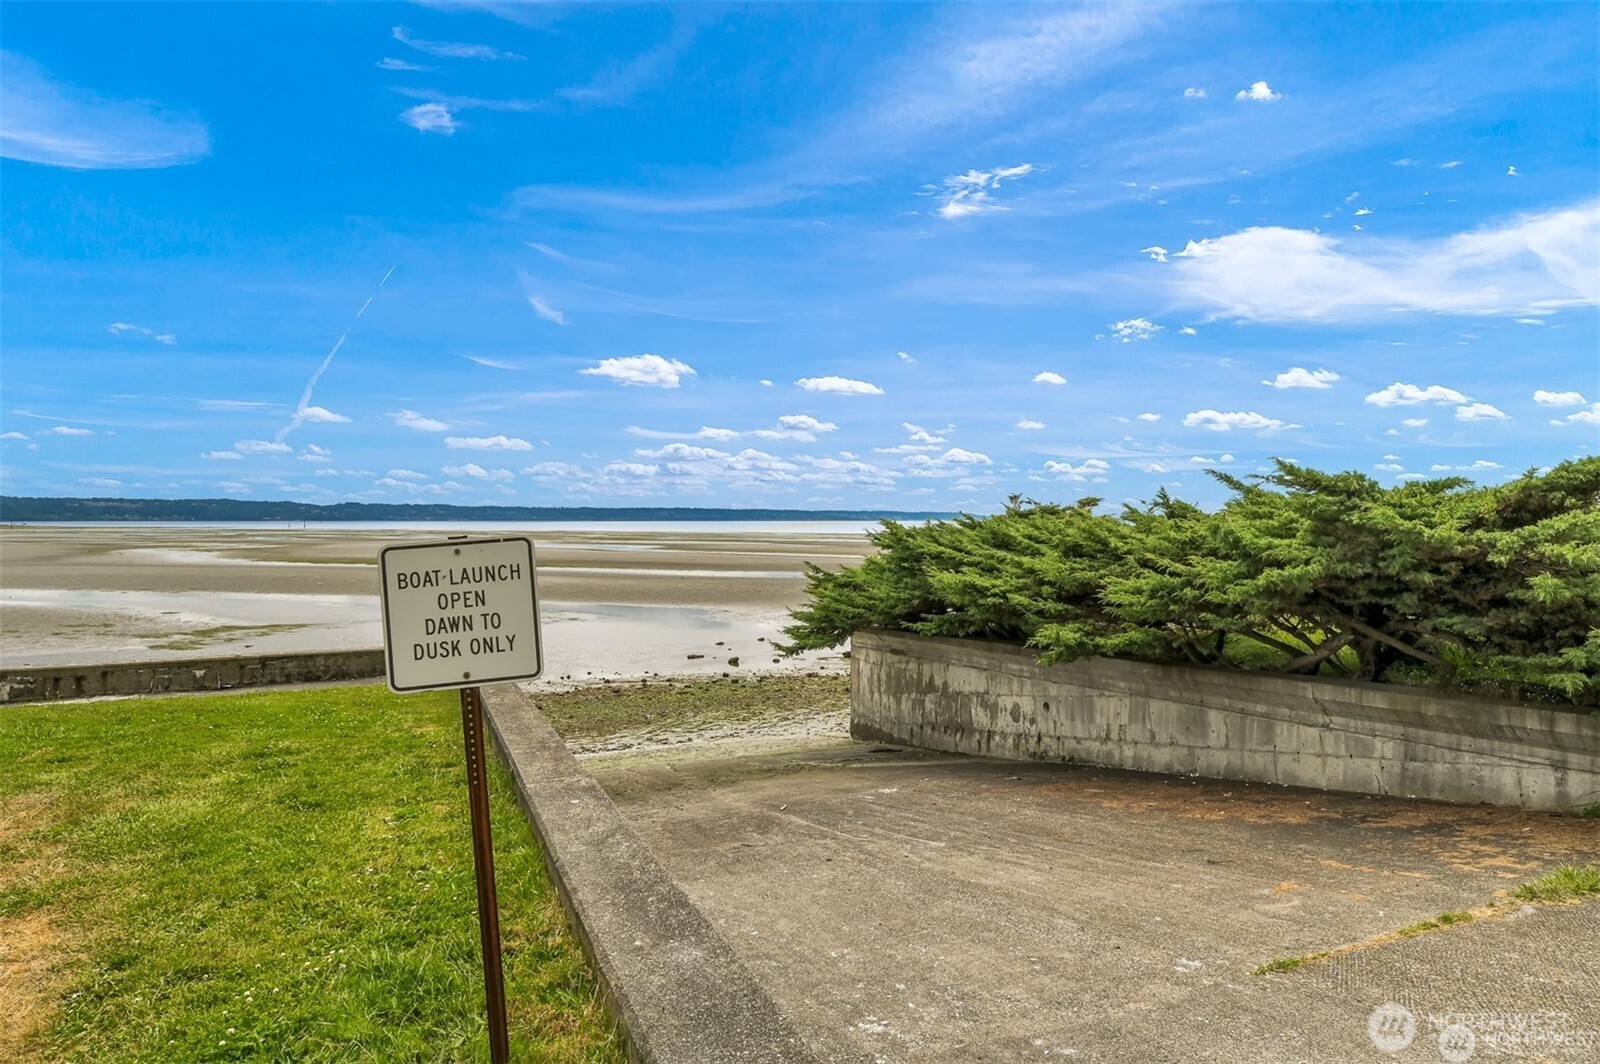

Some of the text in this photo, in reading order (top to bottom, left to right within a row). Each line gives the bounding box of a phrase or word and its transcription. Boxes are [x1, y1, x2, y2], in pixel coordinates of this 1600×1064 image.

[397, 563, 521, 590] BOAT LAUNCH
[437, 590, 486, 610] OPEN
[425, 612, 501, 635] DAWN TO
[413, 634, 516, 661] DUSK ONLY
